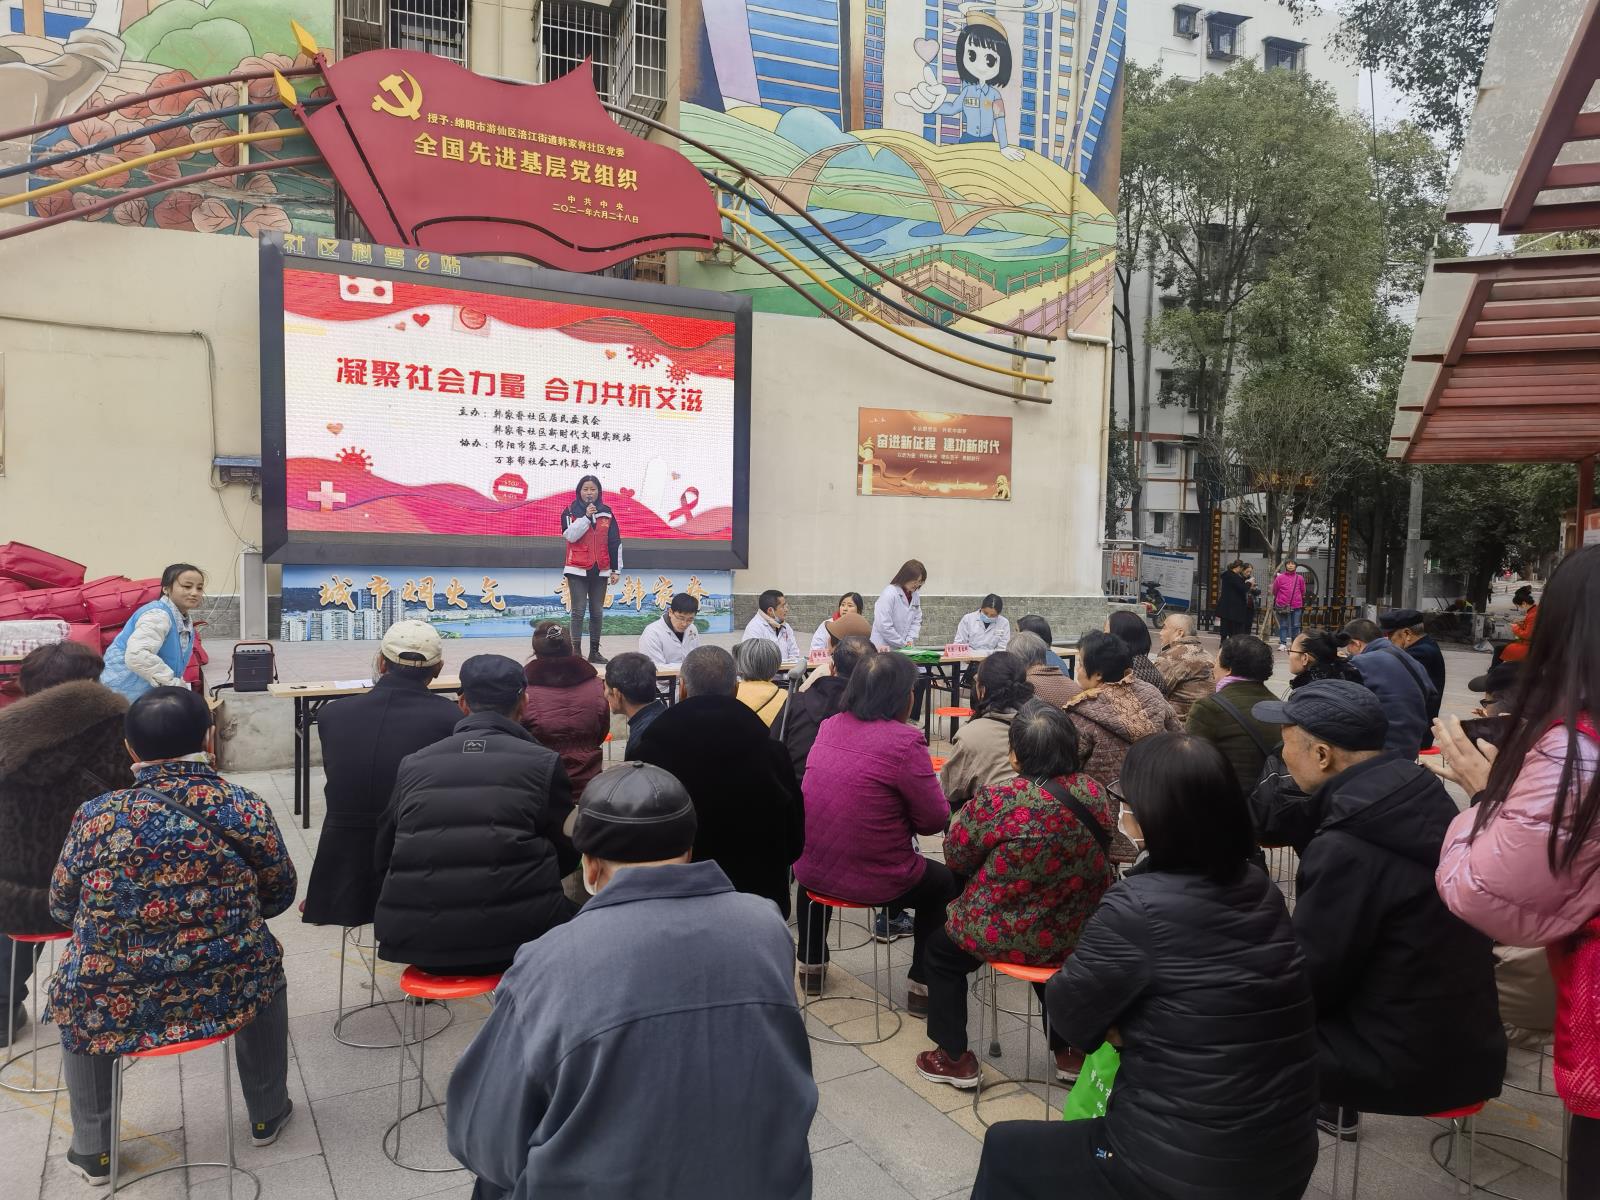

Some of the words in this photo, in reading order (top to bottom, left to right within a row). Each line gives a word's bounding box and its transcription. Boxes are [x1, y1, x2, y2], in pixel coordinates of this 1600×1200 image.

[414, 131, 638, 192] 全国先进基层党组织
[567, 194, 624, 211] 中共中央
[336, 357, 526, 400] 凝聚社会力量
[545, 377, 703, 412] 合力共抗艾滋
[877, 433, 936, 451] 奋进新征程
[943, 437, 1000, 455] 建功新时代
[494, 455, 612, 469] 万事帮社会工作服务中心
[318, 575, 507, 612] 城市烟火气
